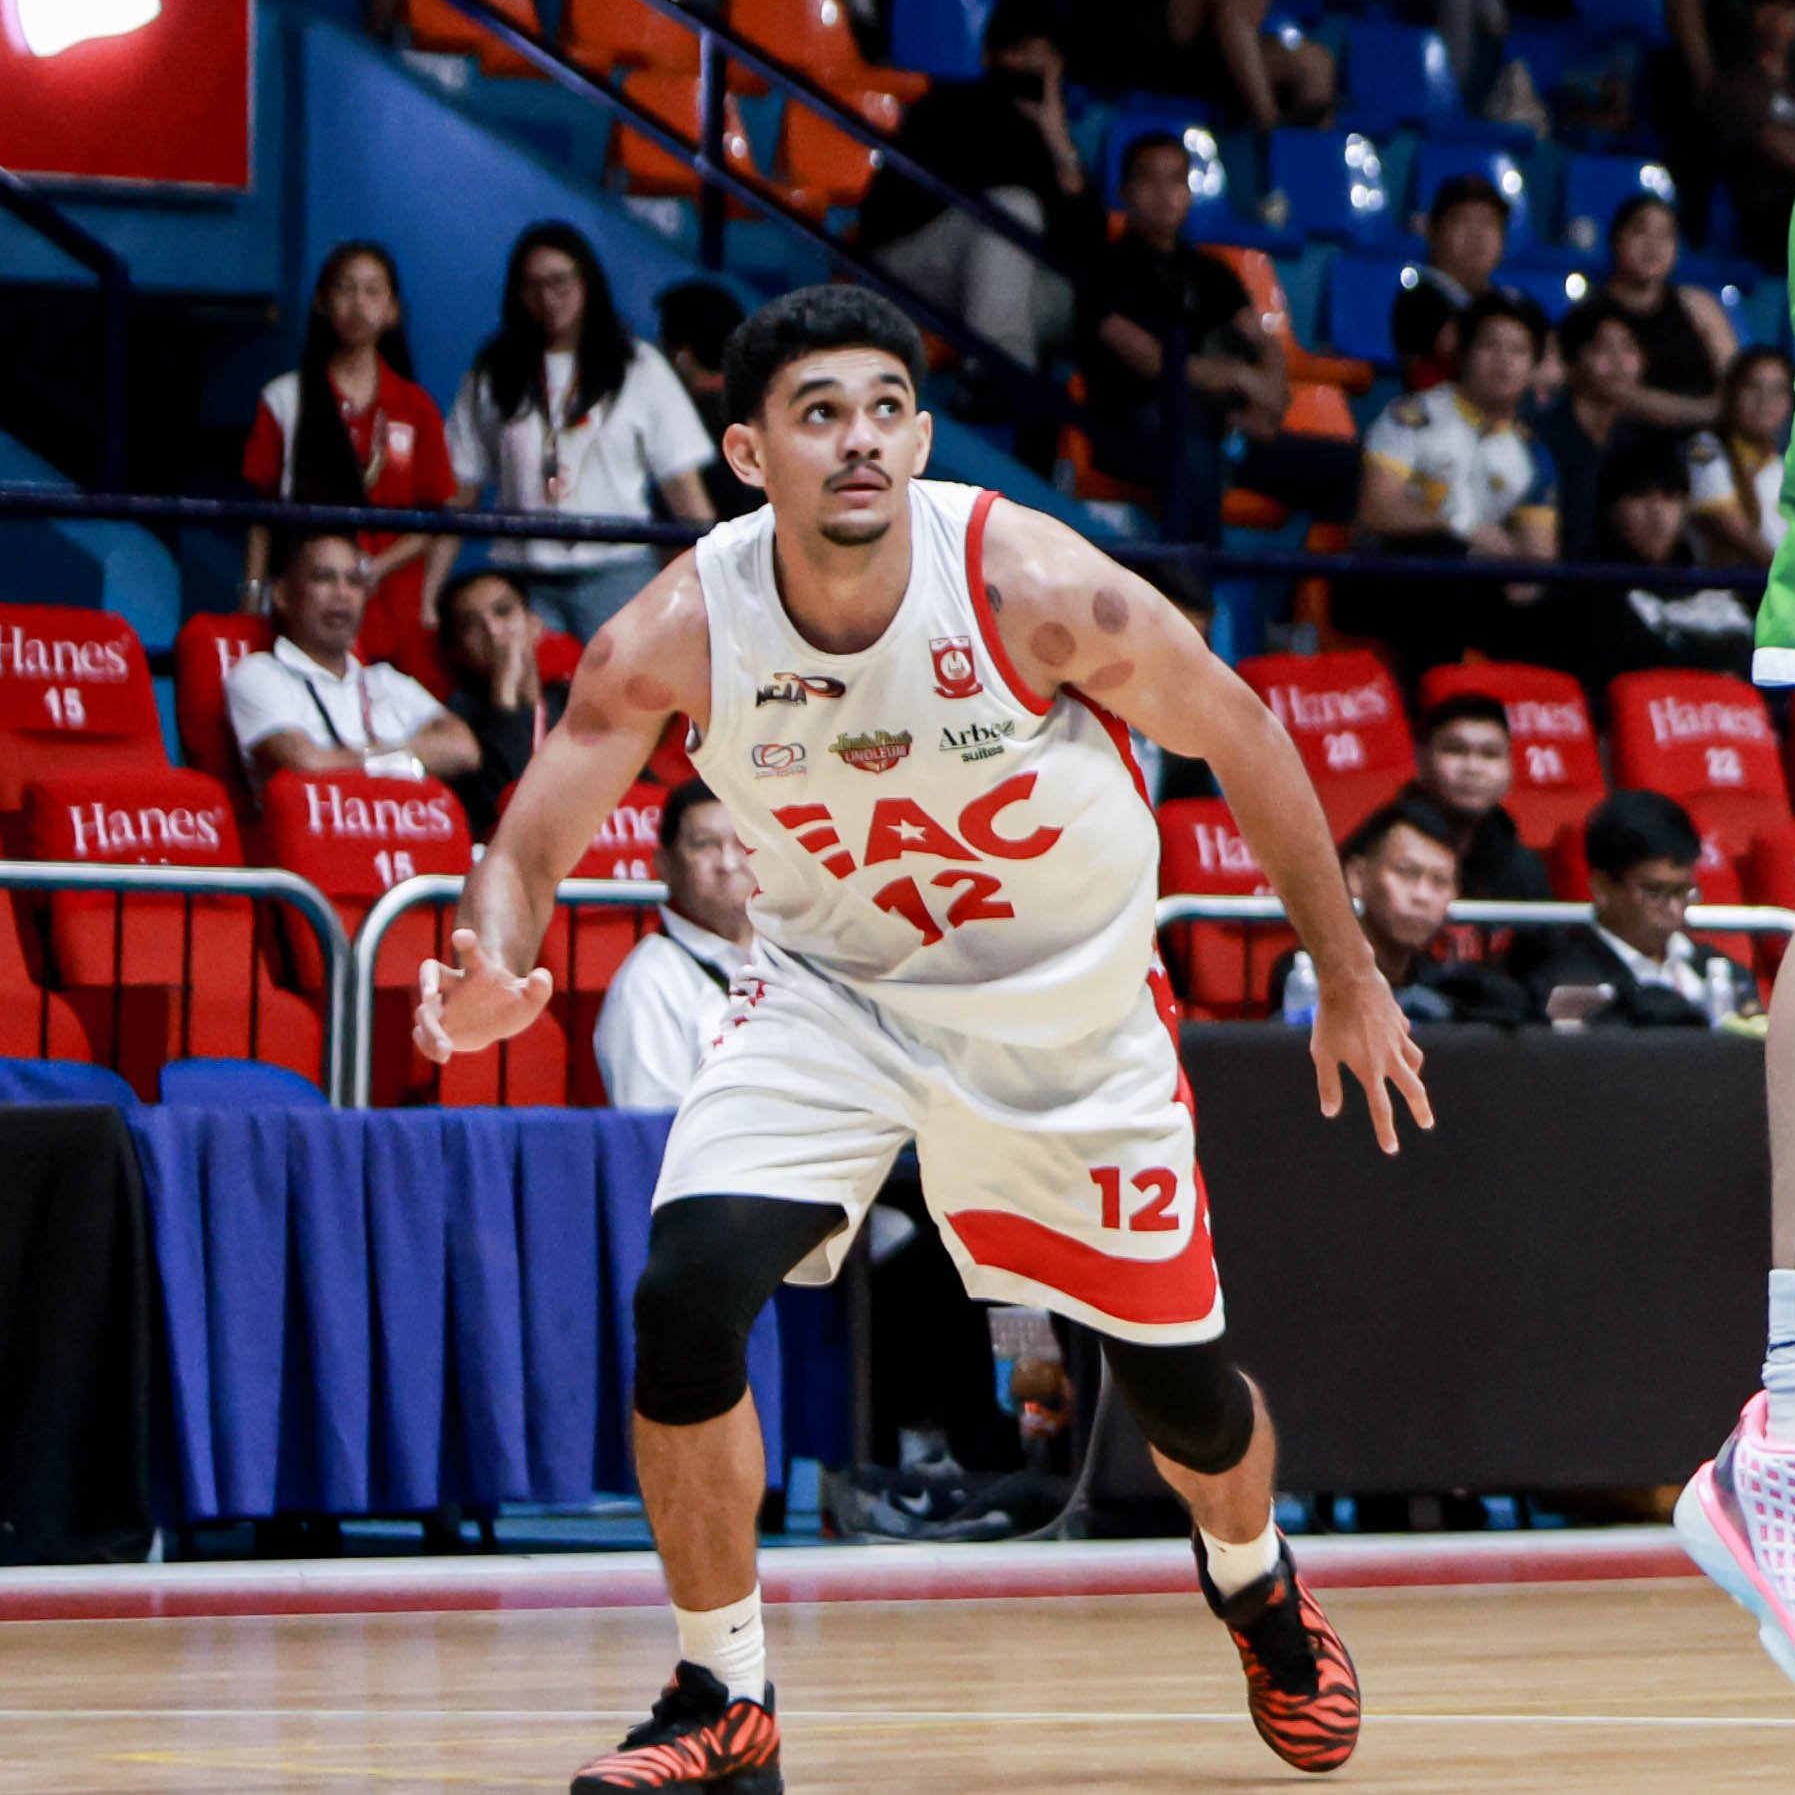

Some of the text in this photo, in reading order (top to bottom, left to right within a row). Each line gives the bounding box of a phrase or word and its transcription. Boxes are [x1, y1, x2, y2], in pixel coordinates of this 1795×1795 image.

[68, 802, 221, 857] Hanes
[304, 782, 455, 838] Hanes
[770, 770, 1064, 880] EAC
[872, 869, 1015, 947] 12
[1089, 1165, 1180, 1233] 12
